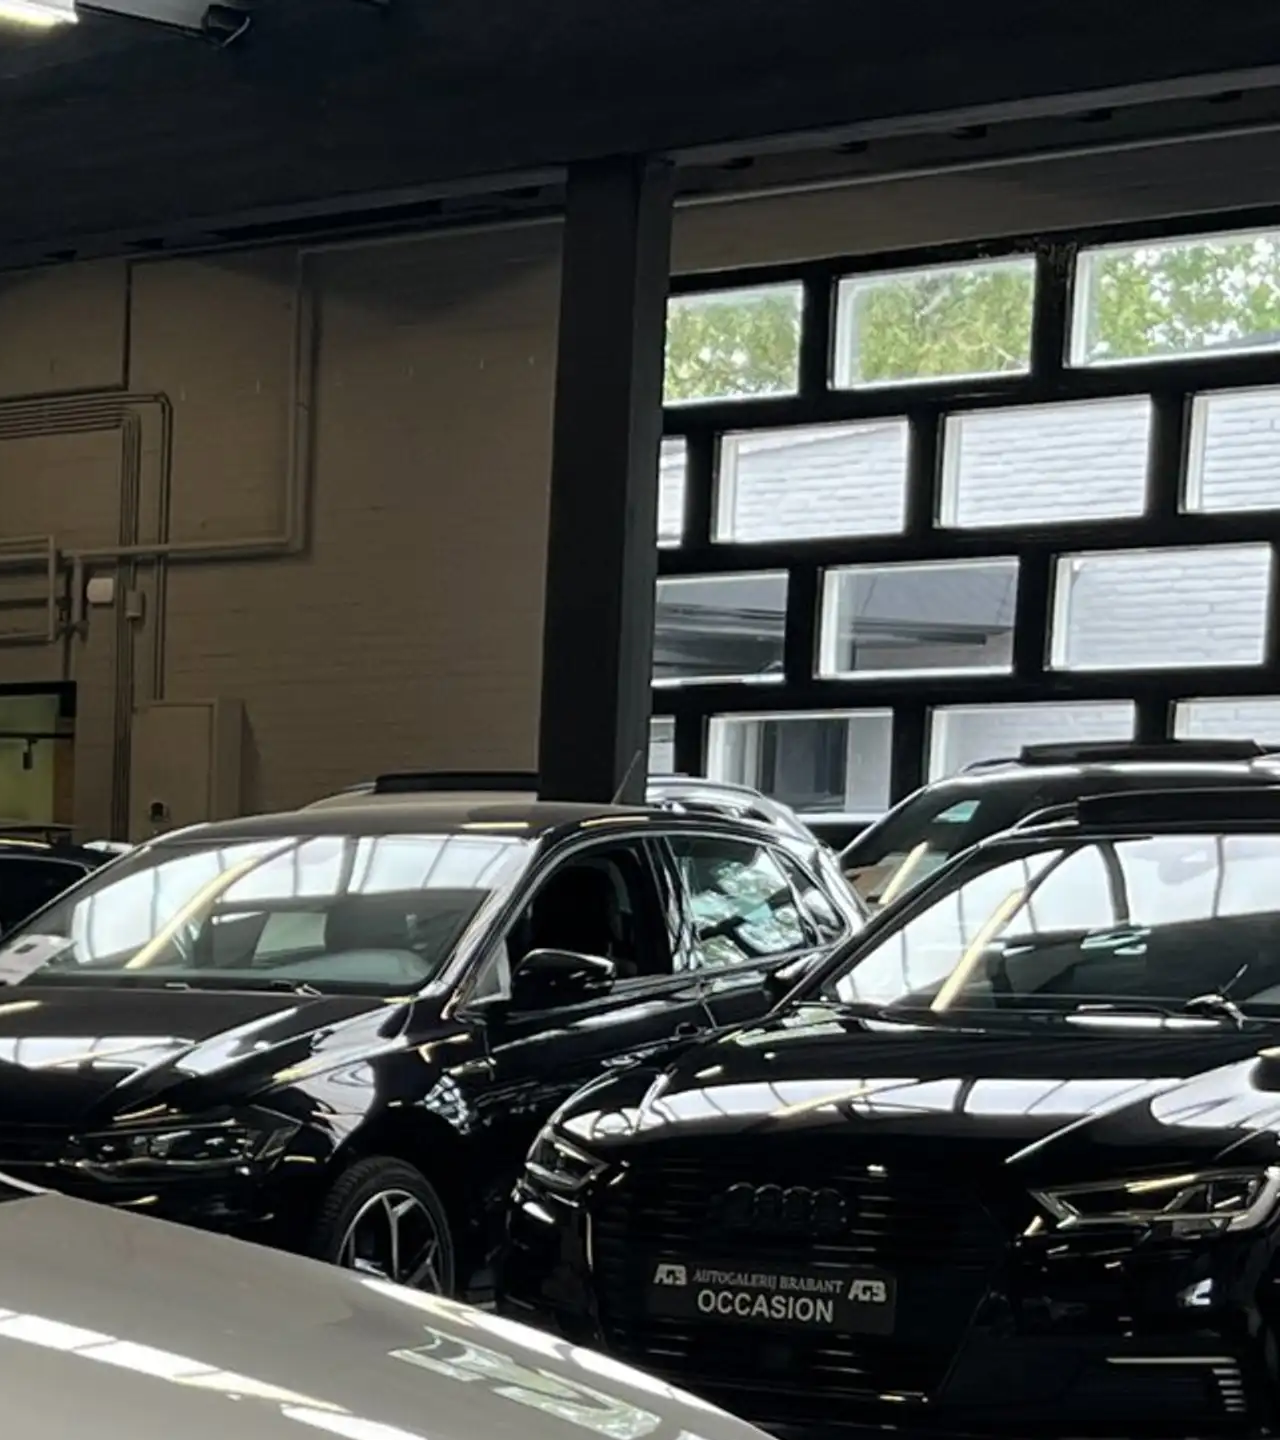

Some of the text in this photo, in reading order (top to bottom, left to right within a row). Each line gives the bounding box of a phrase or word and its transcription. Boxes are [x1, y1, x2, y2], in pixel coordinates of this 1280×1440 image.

[692, 1268, 844, 1294] AUTOGALERIJ BRABANT
[697, 1290, 834, 1323] OCCASION
